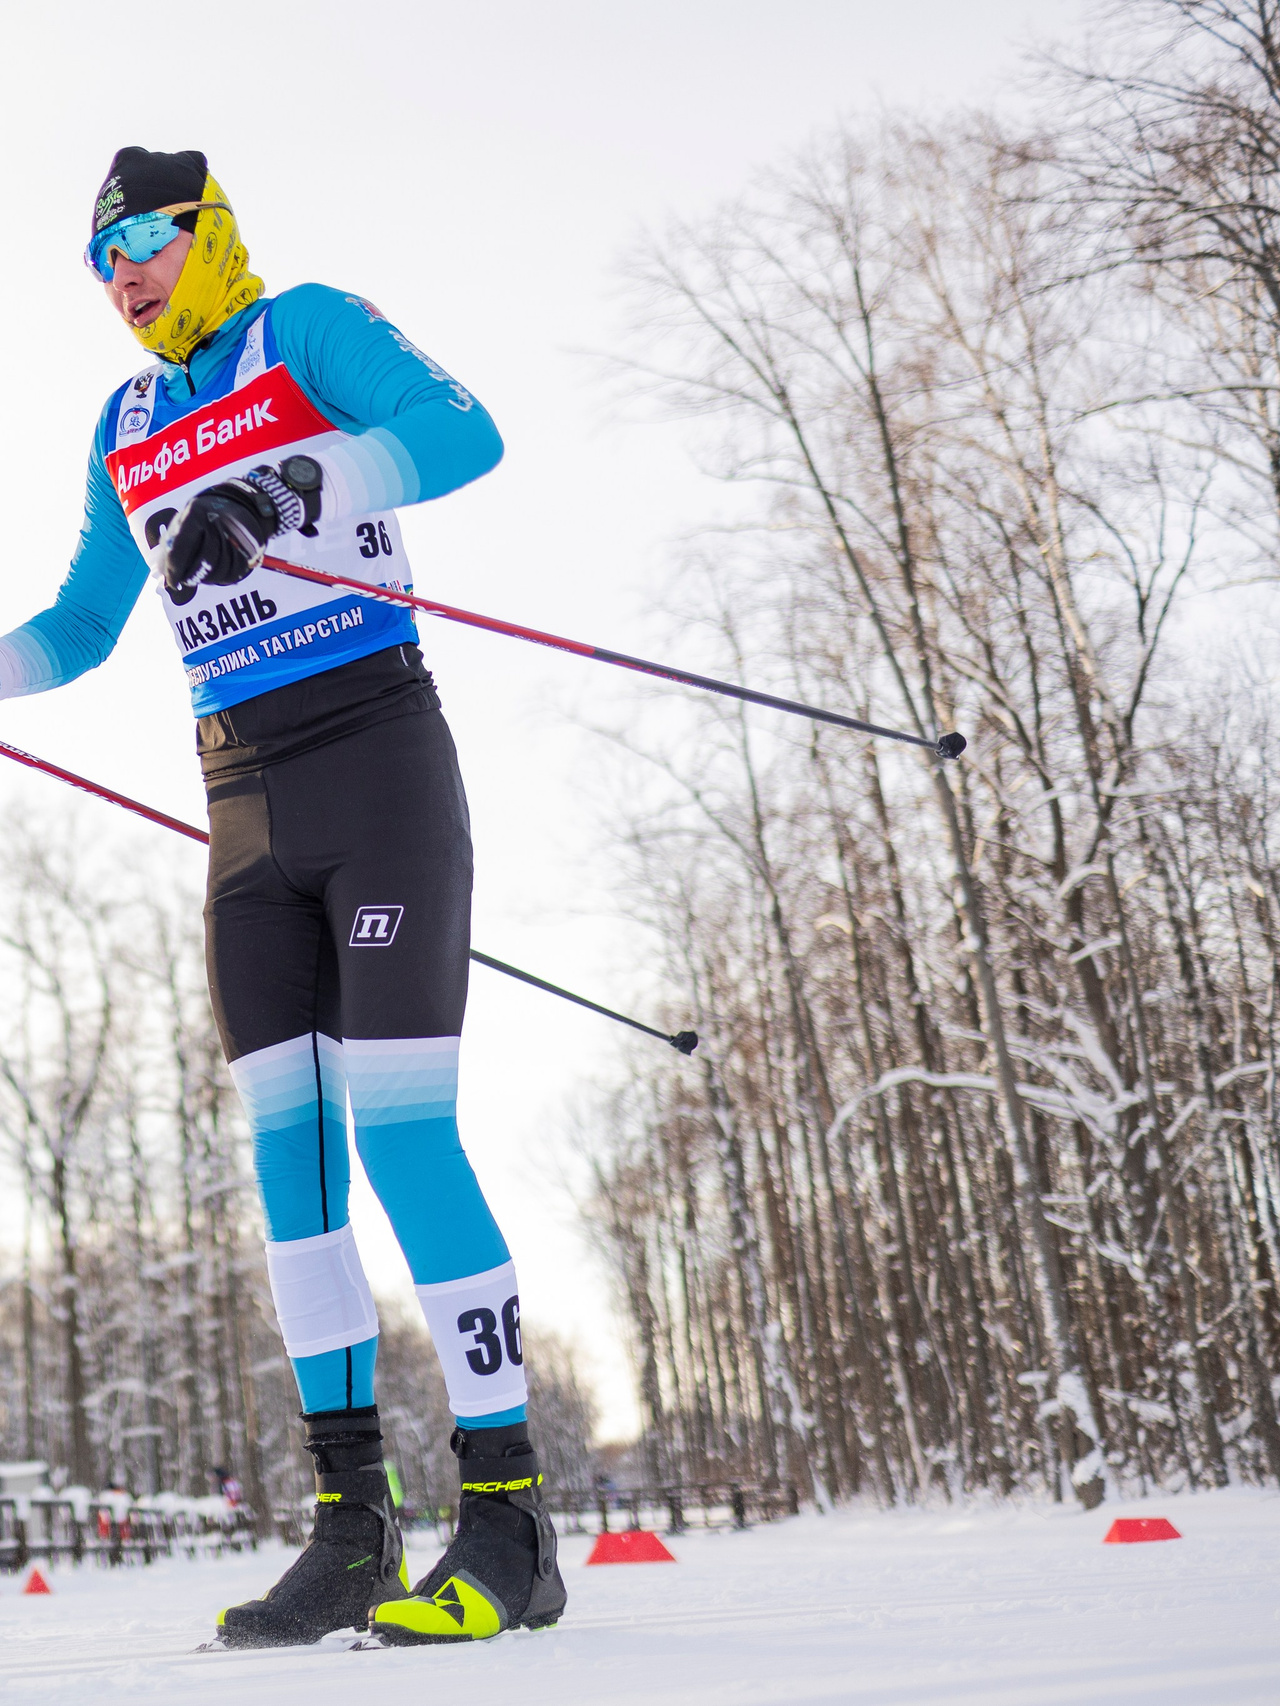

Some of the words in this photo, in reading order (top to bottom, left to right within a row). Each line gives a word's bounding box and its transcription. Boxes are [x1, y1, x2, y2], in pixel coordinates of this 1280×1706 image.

[117, 438, 191, 495] Альфа
[196, 398, 279, 455] Банк
[355, 520, 393, 559] 36
[176, 590, 278, 652] КАЗАНЬ
[259, 605, 365, 658] ТАТАРСТАН
[457, 1295, 523, 1376] 36
[462, 1477, 533, 1493] FISCHER
